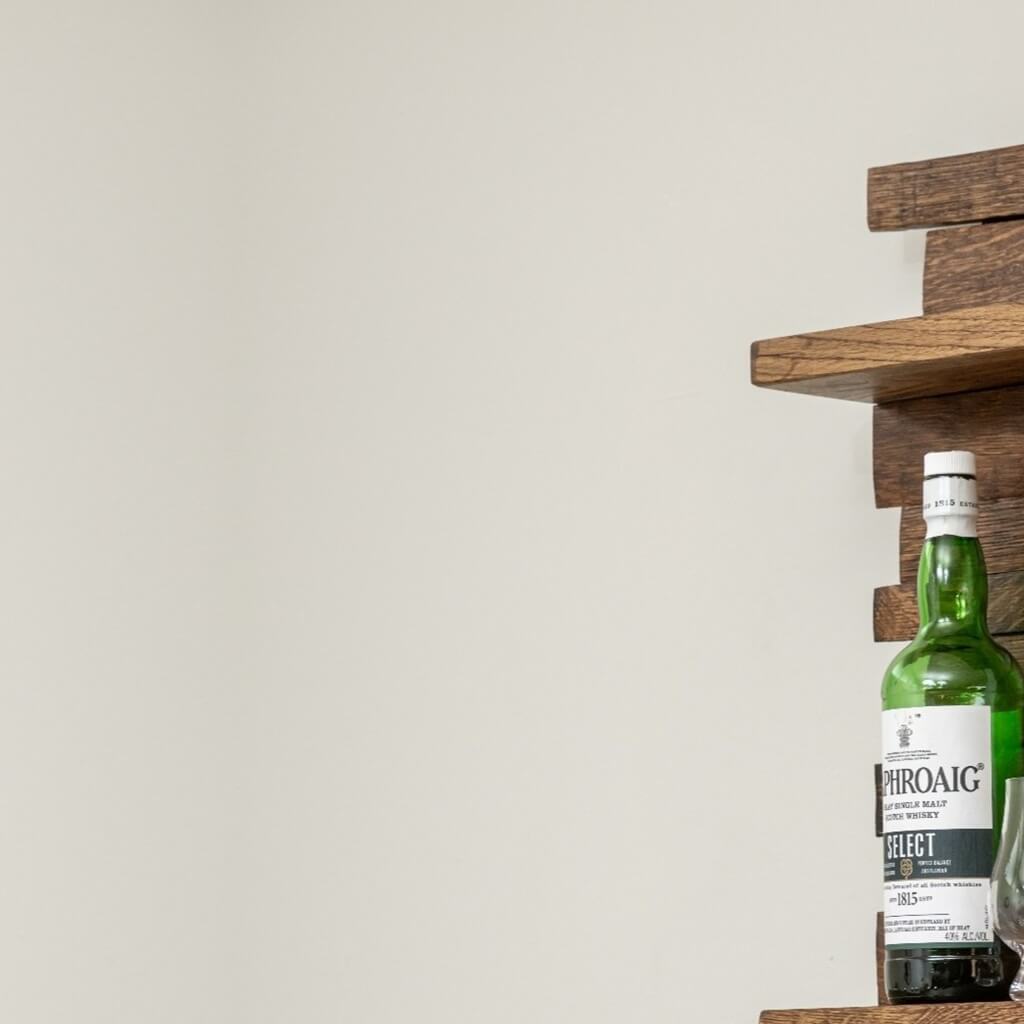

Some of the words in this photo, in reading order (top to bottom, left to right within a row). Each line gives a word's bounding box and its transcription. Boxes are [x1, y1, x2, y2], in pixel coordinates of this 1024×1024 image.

[922, 800, 948, 808] MALT
[906, 811, 940, 820] WHISKY
[887, 832, 937, 860] SELECT
[897, 891, 919, 907] 1815
